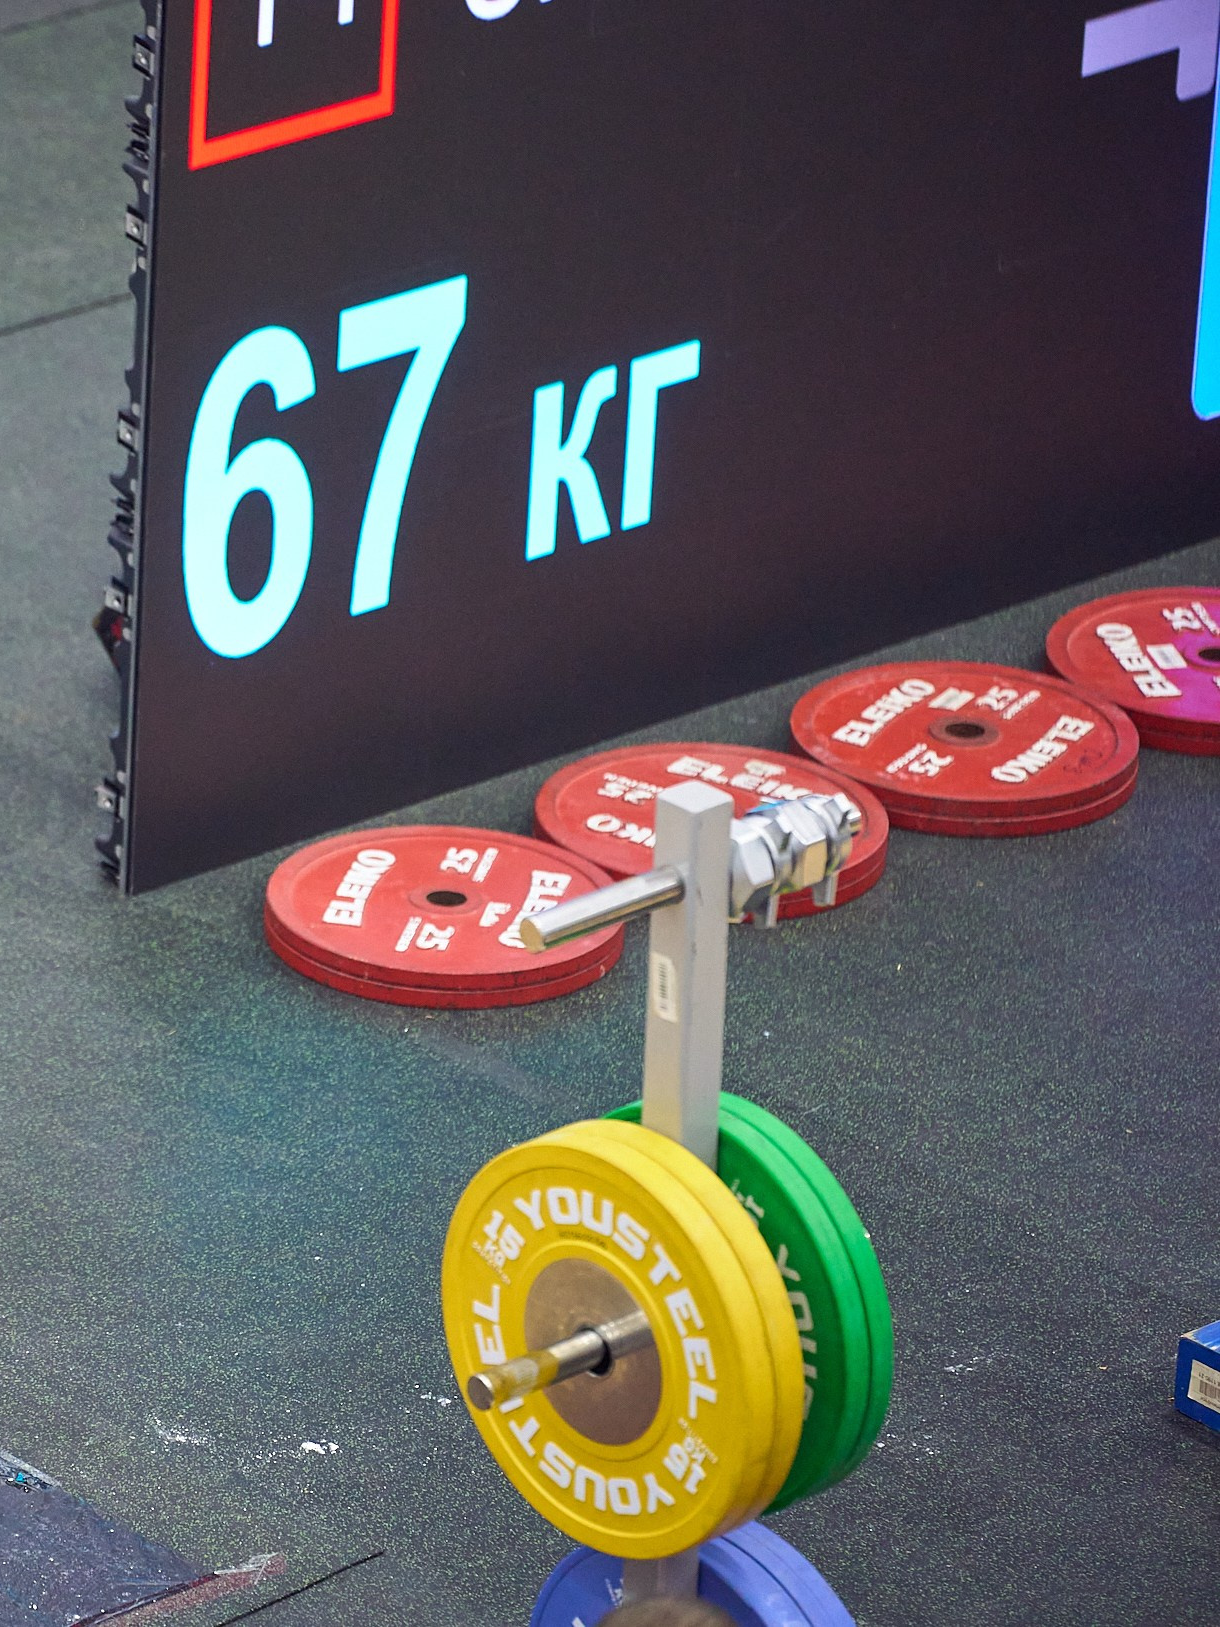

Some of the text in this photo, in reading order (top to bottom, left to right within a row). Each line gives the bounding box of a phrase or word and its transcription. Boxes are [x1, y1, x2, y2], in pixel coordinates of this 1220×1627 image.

[182, 275, 468, 659] 67
[1096, 623, 1182, 697] ELEIKO
[832, 678, 936, 748] ELEIKO
[990, 715, 1095, 783] ELEIKO
[666, 756, 812, 800] ELEIK
[322, 849, 396, 927] ELEIKO
[483, 1209, 526, 1261] 15
[513, 1187, 717, 1419] YOUSTEEL
[472, 1284, 676, 1516] YOUSTEL
[663, 1443, 707, 1496] 15
